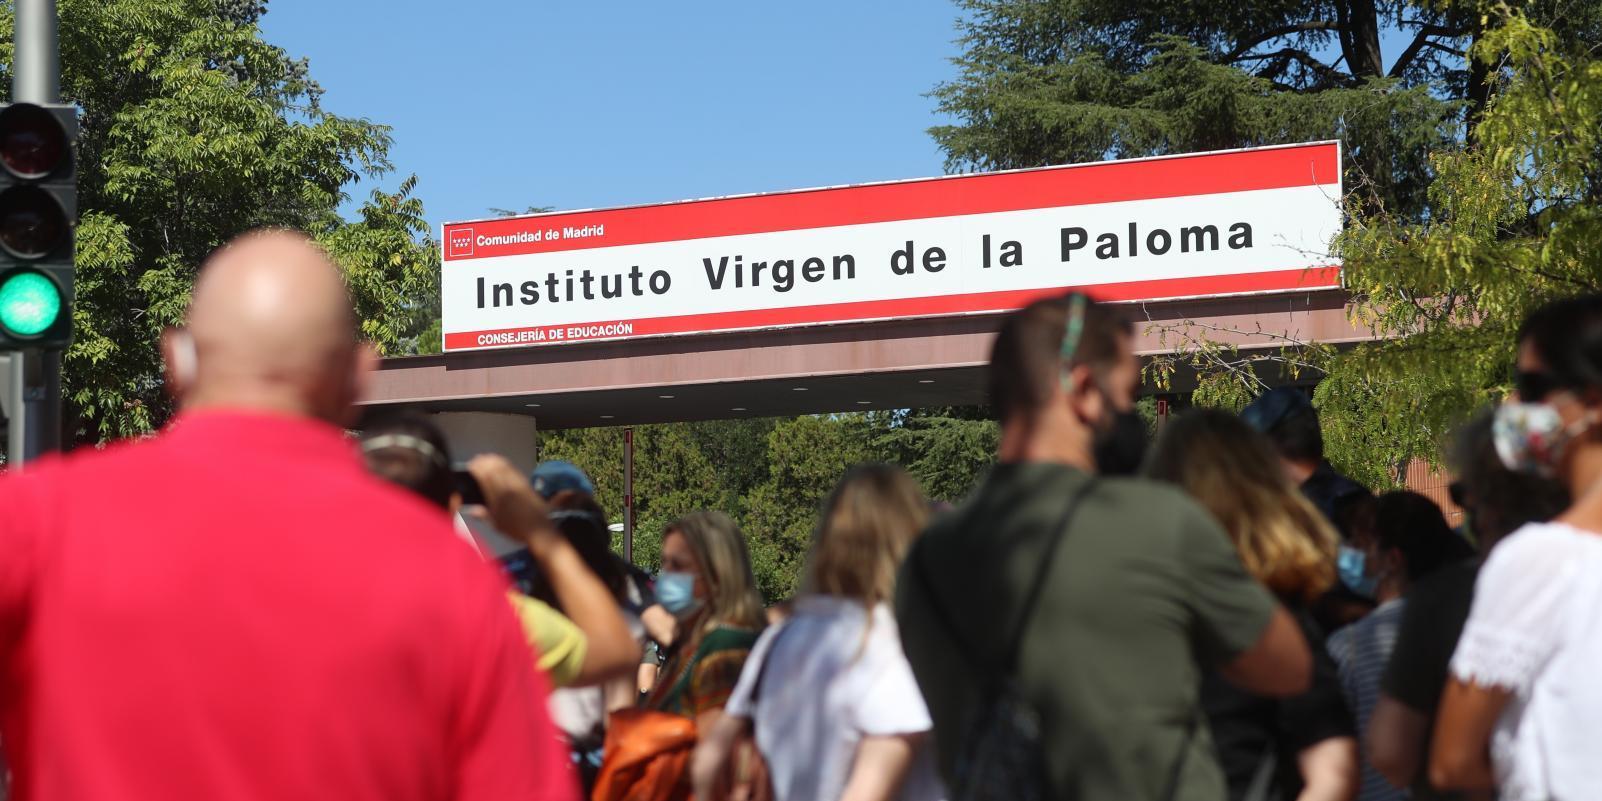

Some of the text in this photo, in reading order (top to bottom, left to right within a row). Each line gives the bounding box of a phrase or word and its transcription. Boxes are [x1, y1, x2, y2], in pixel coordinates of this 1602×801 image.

[476, 224, 604, 247] Comunidad de Madrid
[476, 221, 1253, 309] Instituto Virgen de la Paloma
[477, 322, 633, 345] CONSEJERÍA DE EDUCACIÓN
